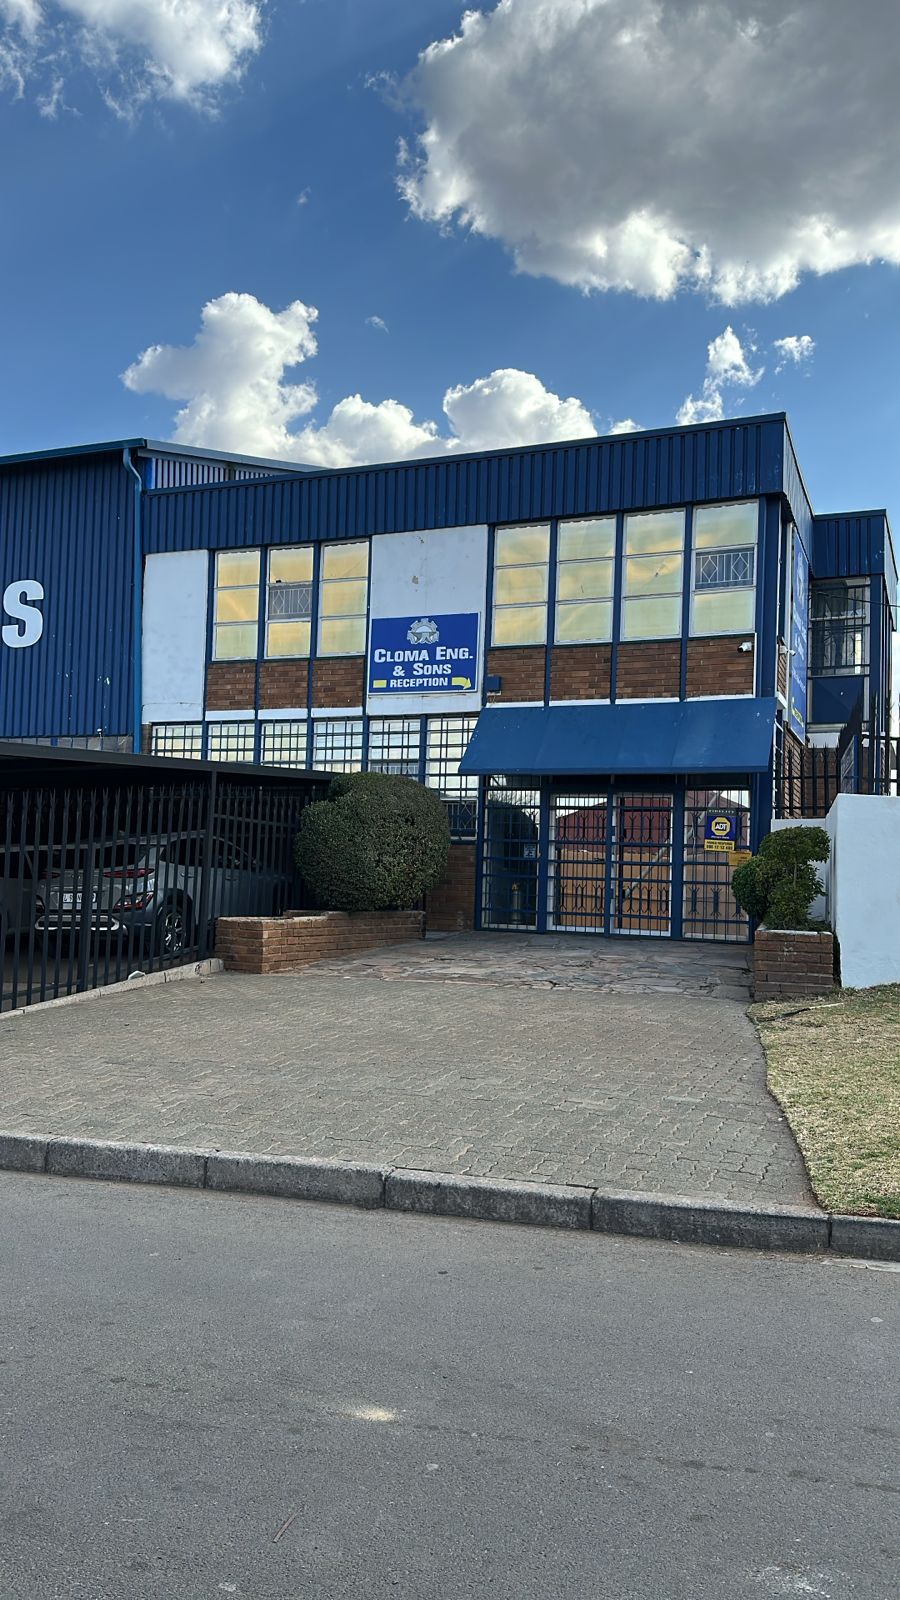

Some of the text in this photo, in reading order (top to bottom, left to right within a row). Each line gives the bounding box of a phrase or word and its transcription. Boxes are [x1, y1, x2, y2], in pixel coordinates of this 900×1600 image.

[2, 580, 44, 648] S
[374, 646, 474, 663] CLOMA ENG.
[393, 662, 452, 677] & SONS
[390, 677, 448, 688] RECEPTION
